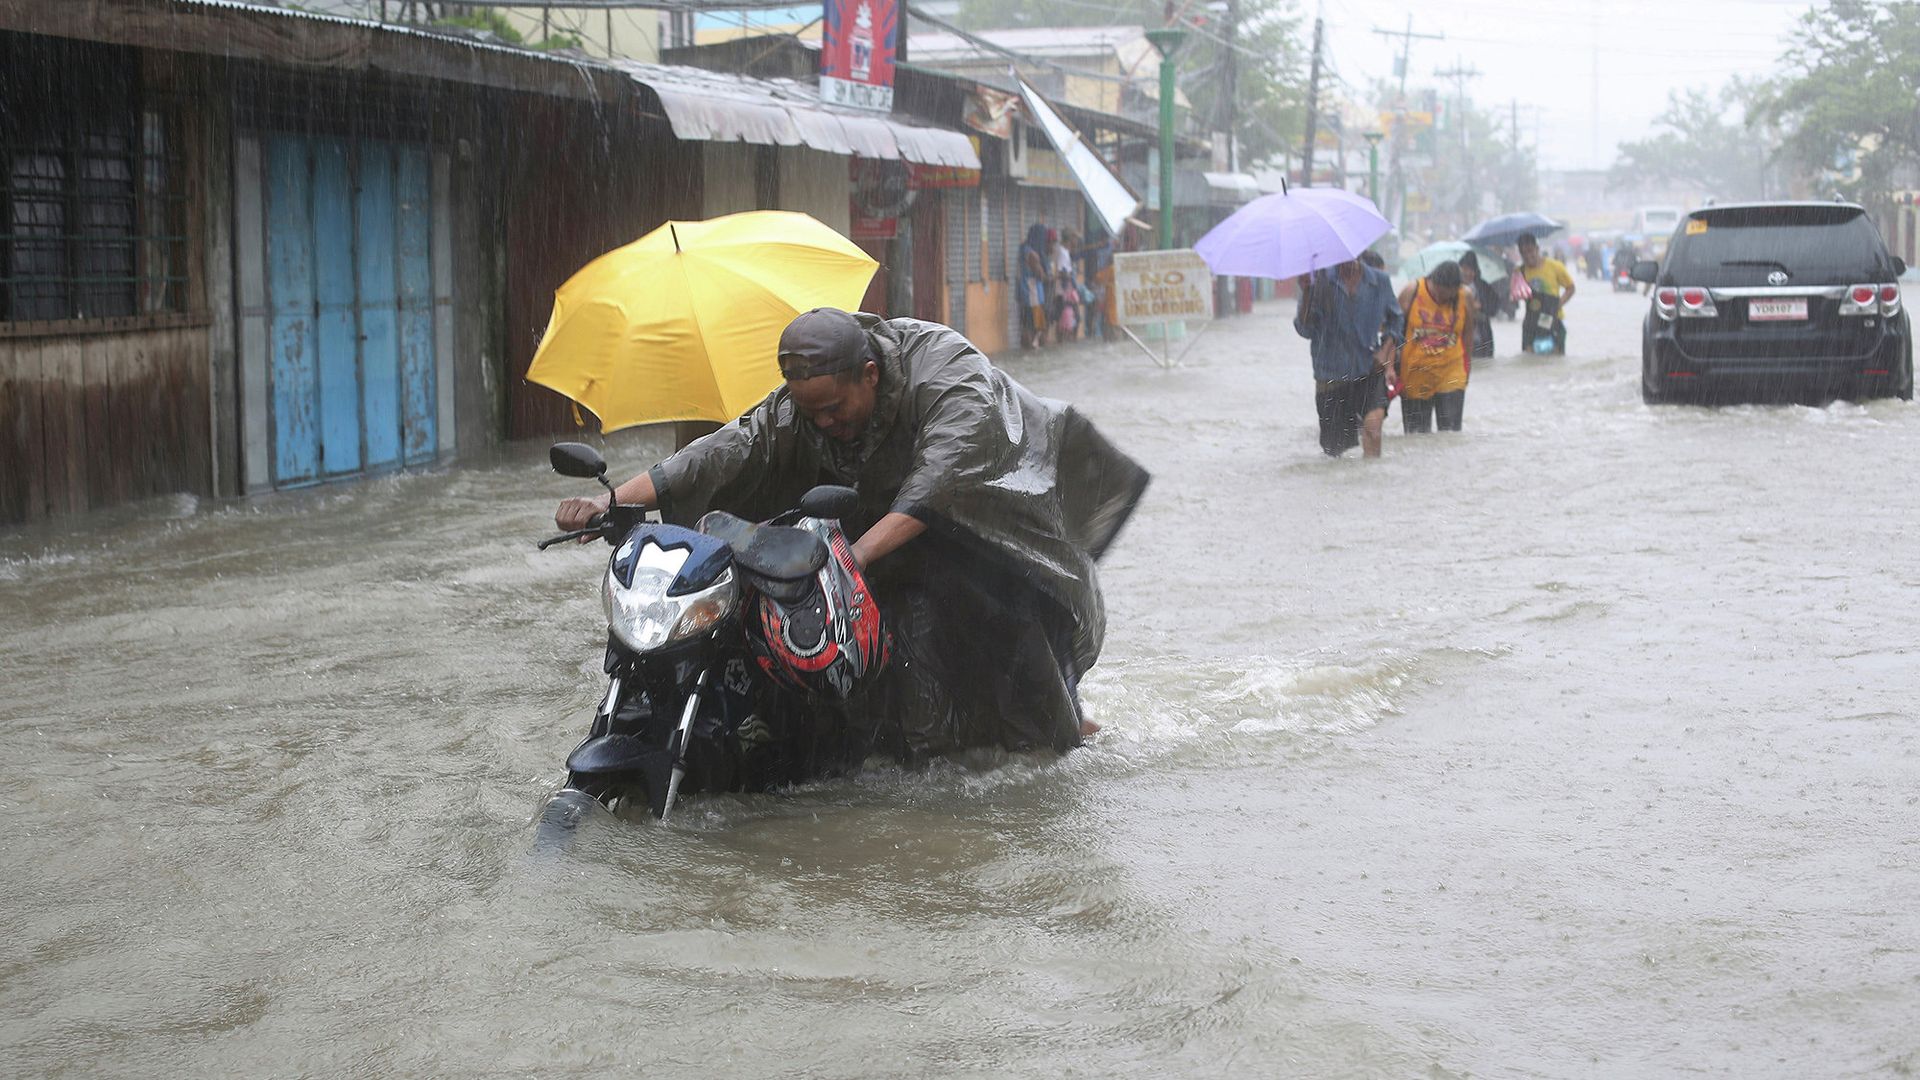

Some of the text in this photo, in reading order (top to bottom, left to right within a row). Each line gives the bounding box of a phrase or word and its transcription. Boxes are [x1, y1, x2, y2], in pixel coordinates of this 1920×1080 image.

[1140, 271, 1184, 286] NO
[1123, 287, 1185, 303] LOADING
[1124, 300, 1204, 316] UNLOADING
